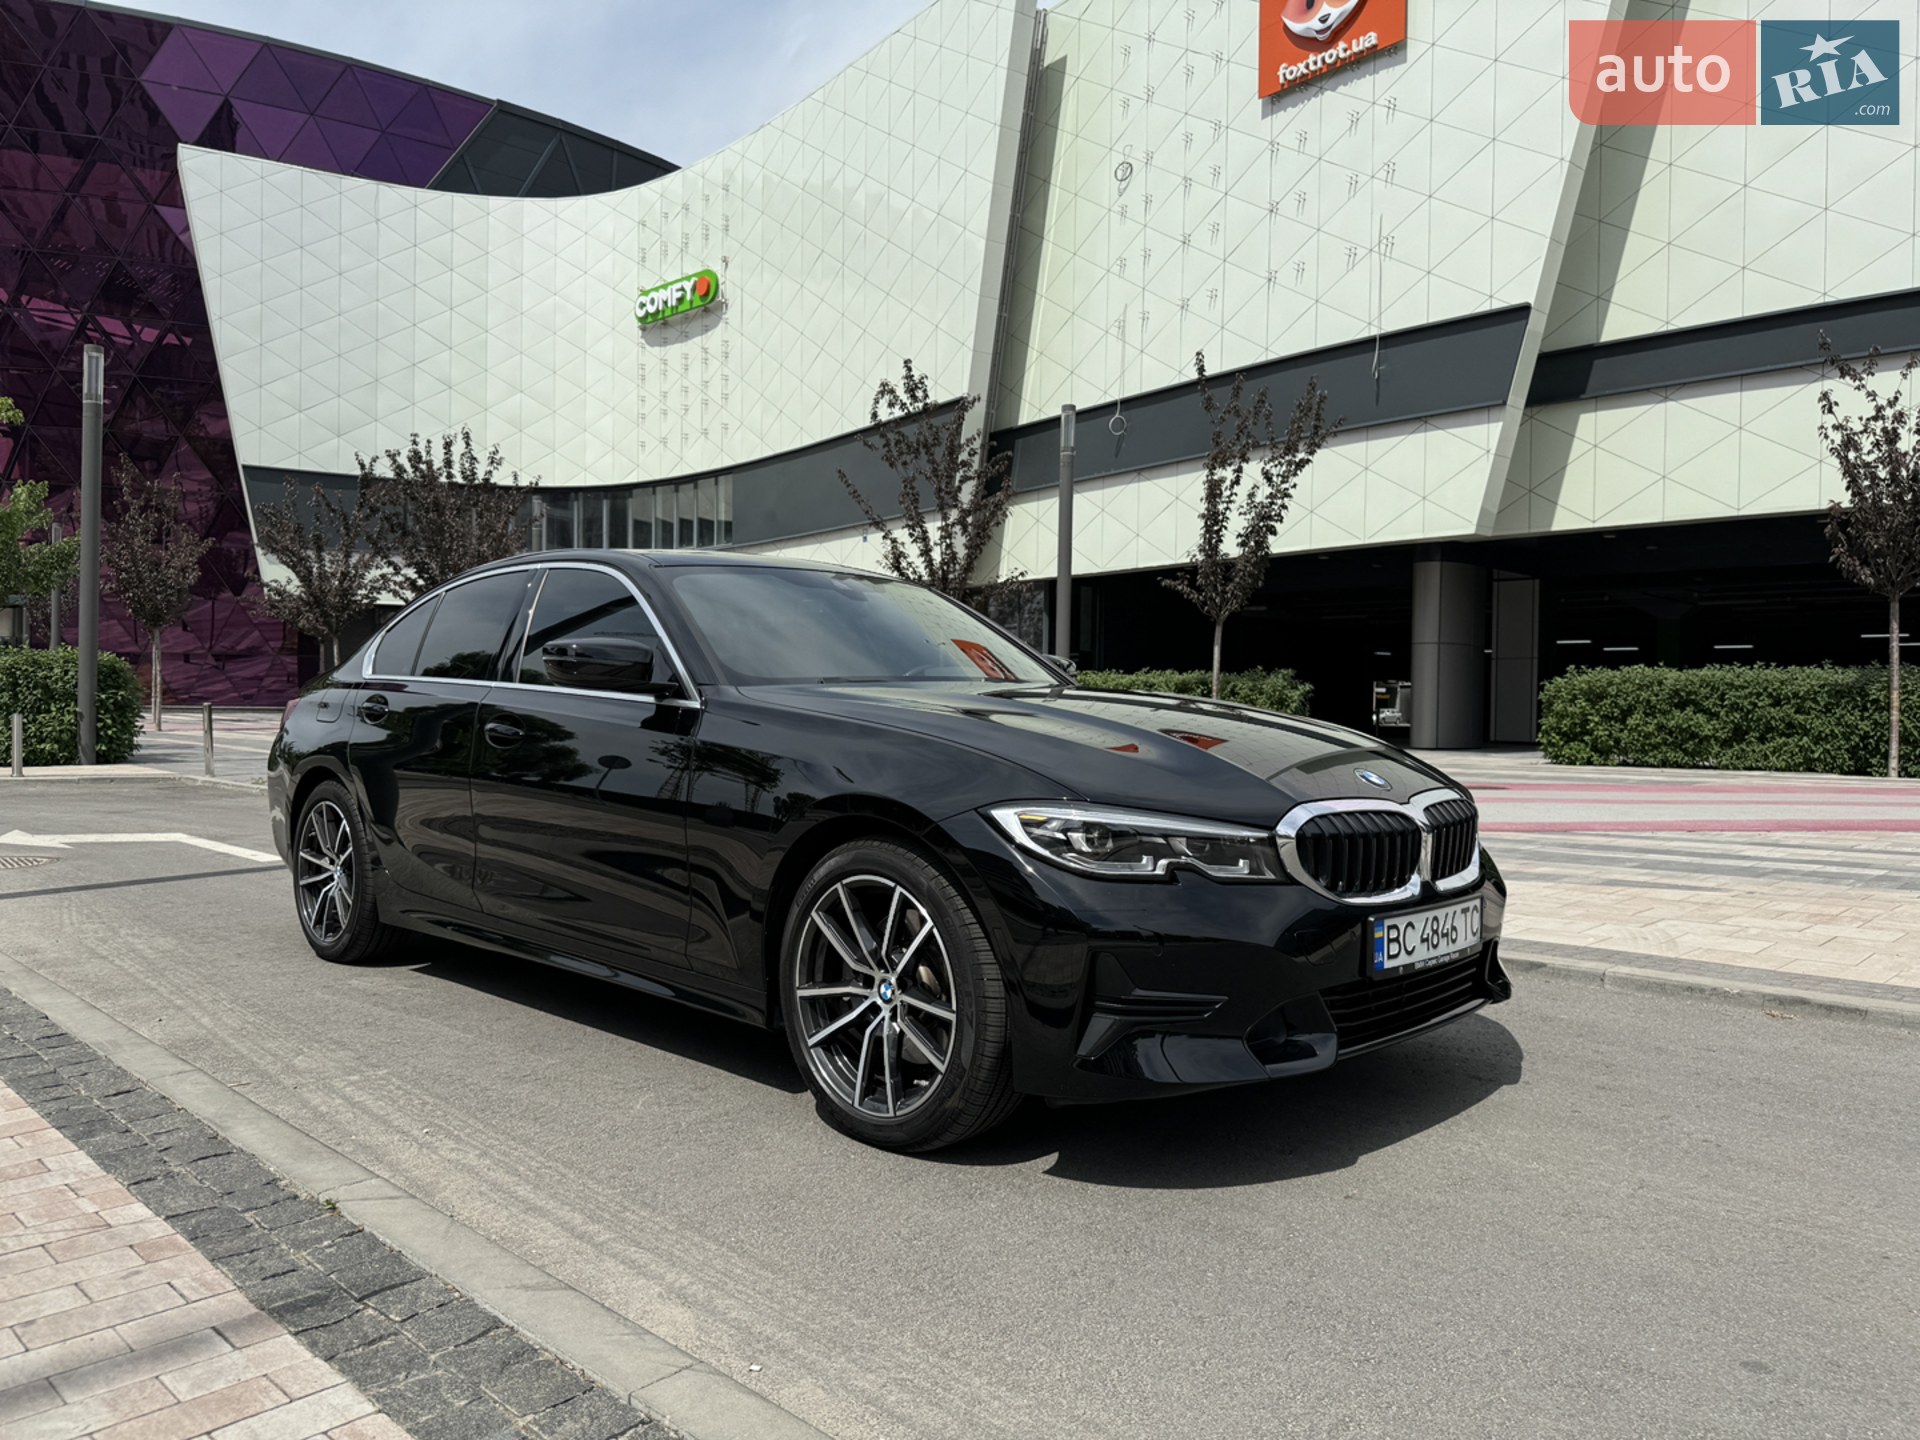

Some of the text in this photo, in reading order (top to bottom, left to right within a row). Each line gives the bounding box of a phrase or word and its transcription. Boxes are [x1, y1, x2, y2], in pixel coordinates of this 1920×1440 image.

[1277, 31, 1378, 84] foxtrot.ua
[635, 277, 698, 318] COMFY
[1386, 905, 1480, 960] BC 4846 TC
